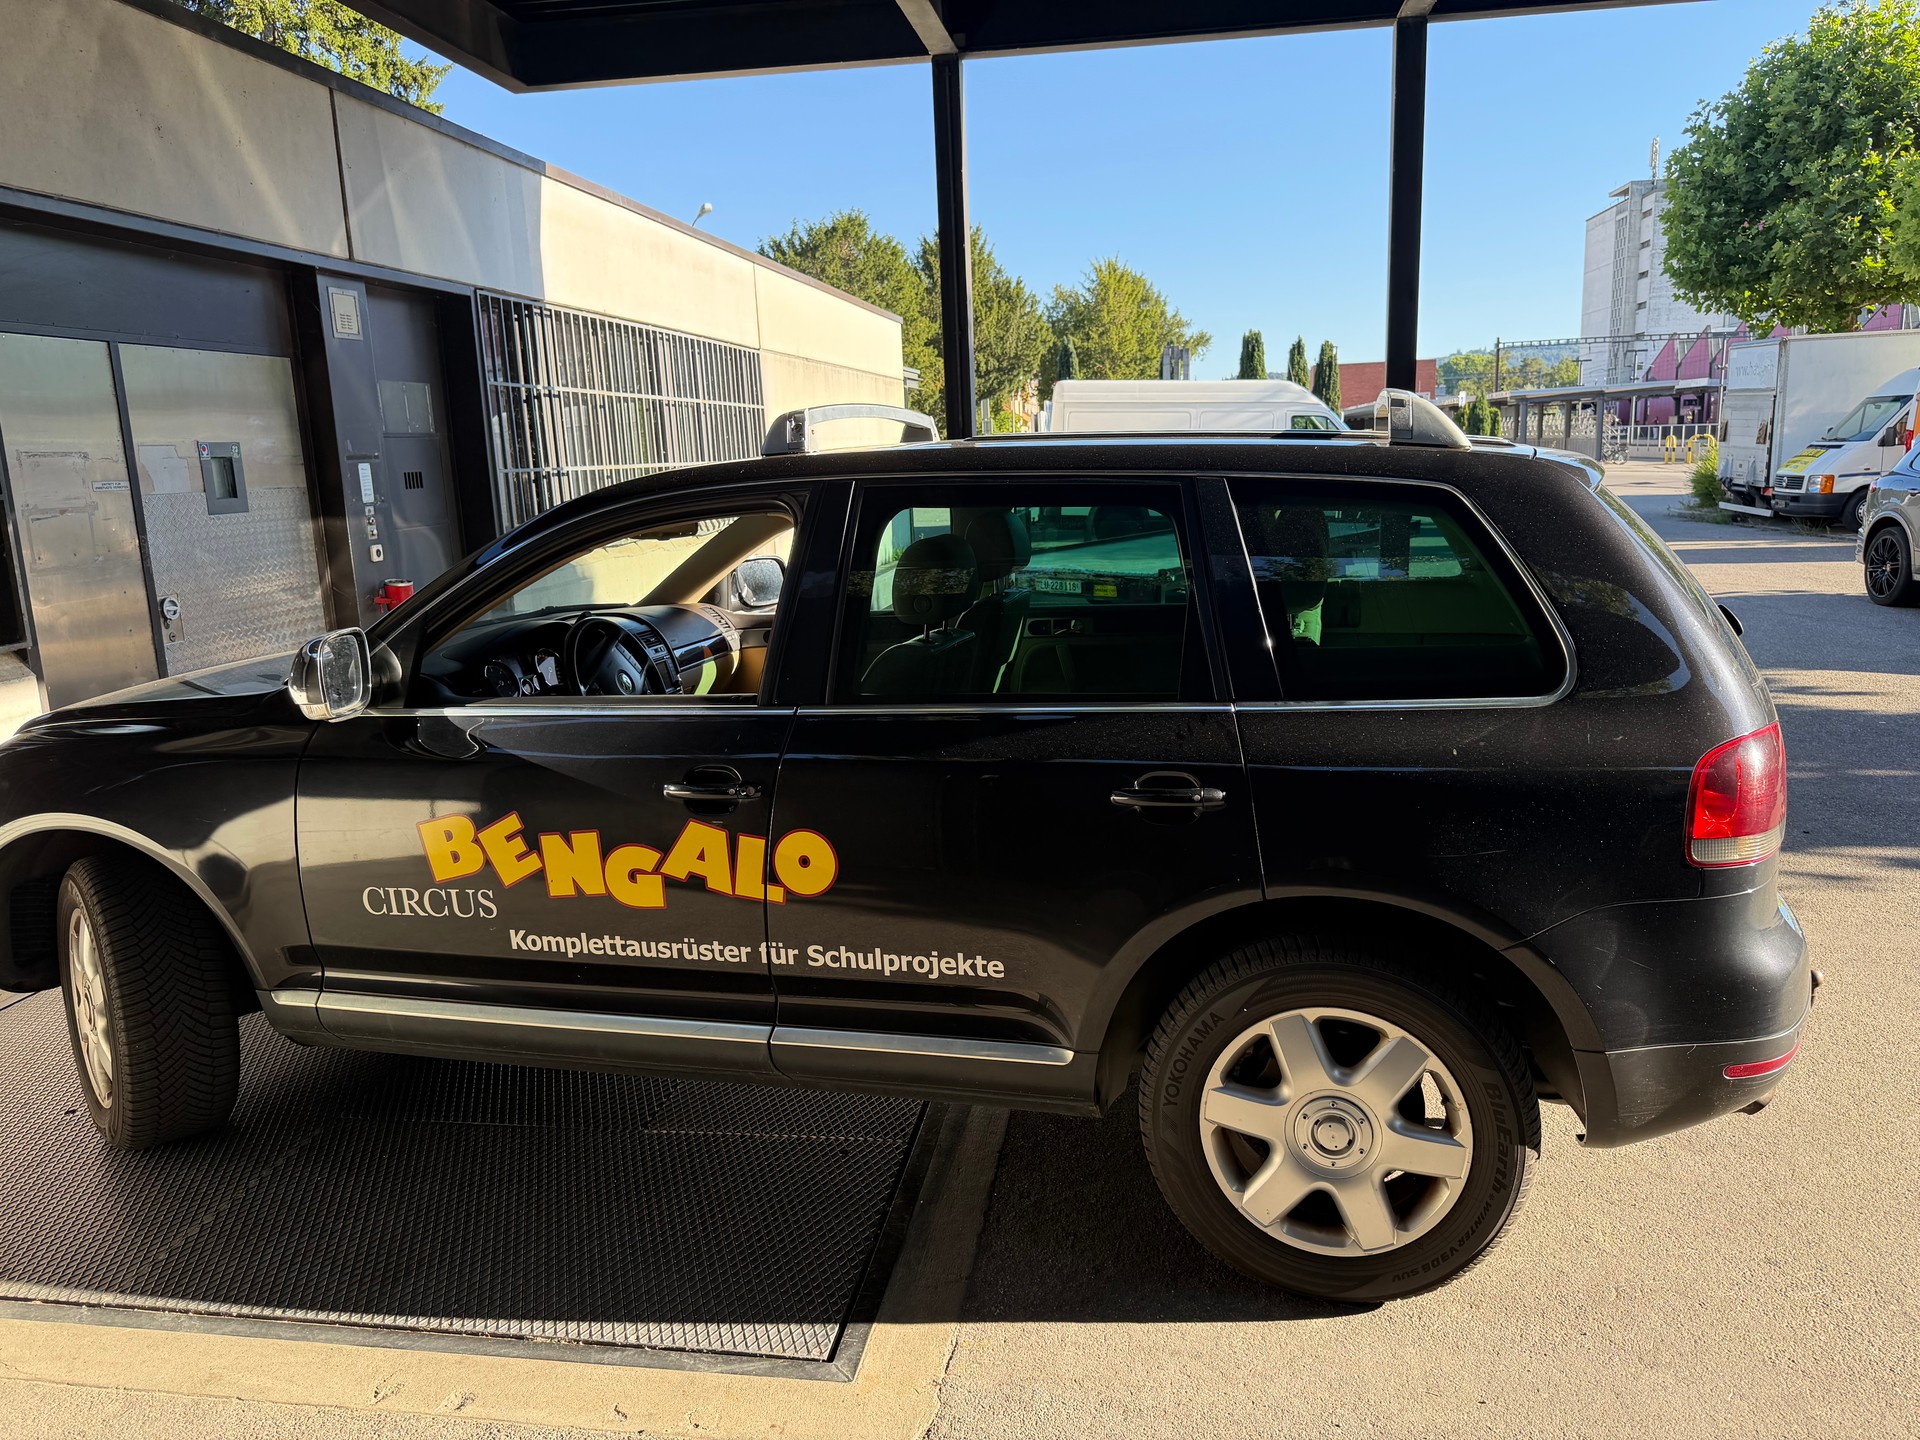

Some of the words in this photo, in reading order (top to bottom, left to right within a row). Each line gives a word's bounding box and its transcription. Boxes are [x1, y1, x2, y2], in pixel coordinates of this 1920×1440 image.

[362, 886, 499, 919] CIRCUS
[417, 811, 839, 910] BENGALO
[509, 929, 752, 964] Komplettausrüster
[758, 941, 799, 965] für
[806, 944, 1006, 980] Schulprojekte
[1162, 1010, 1225, 1107] YOKOHAMA
[1482, 1081, 1512, 1196] BluEarth
